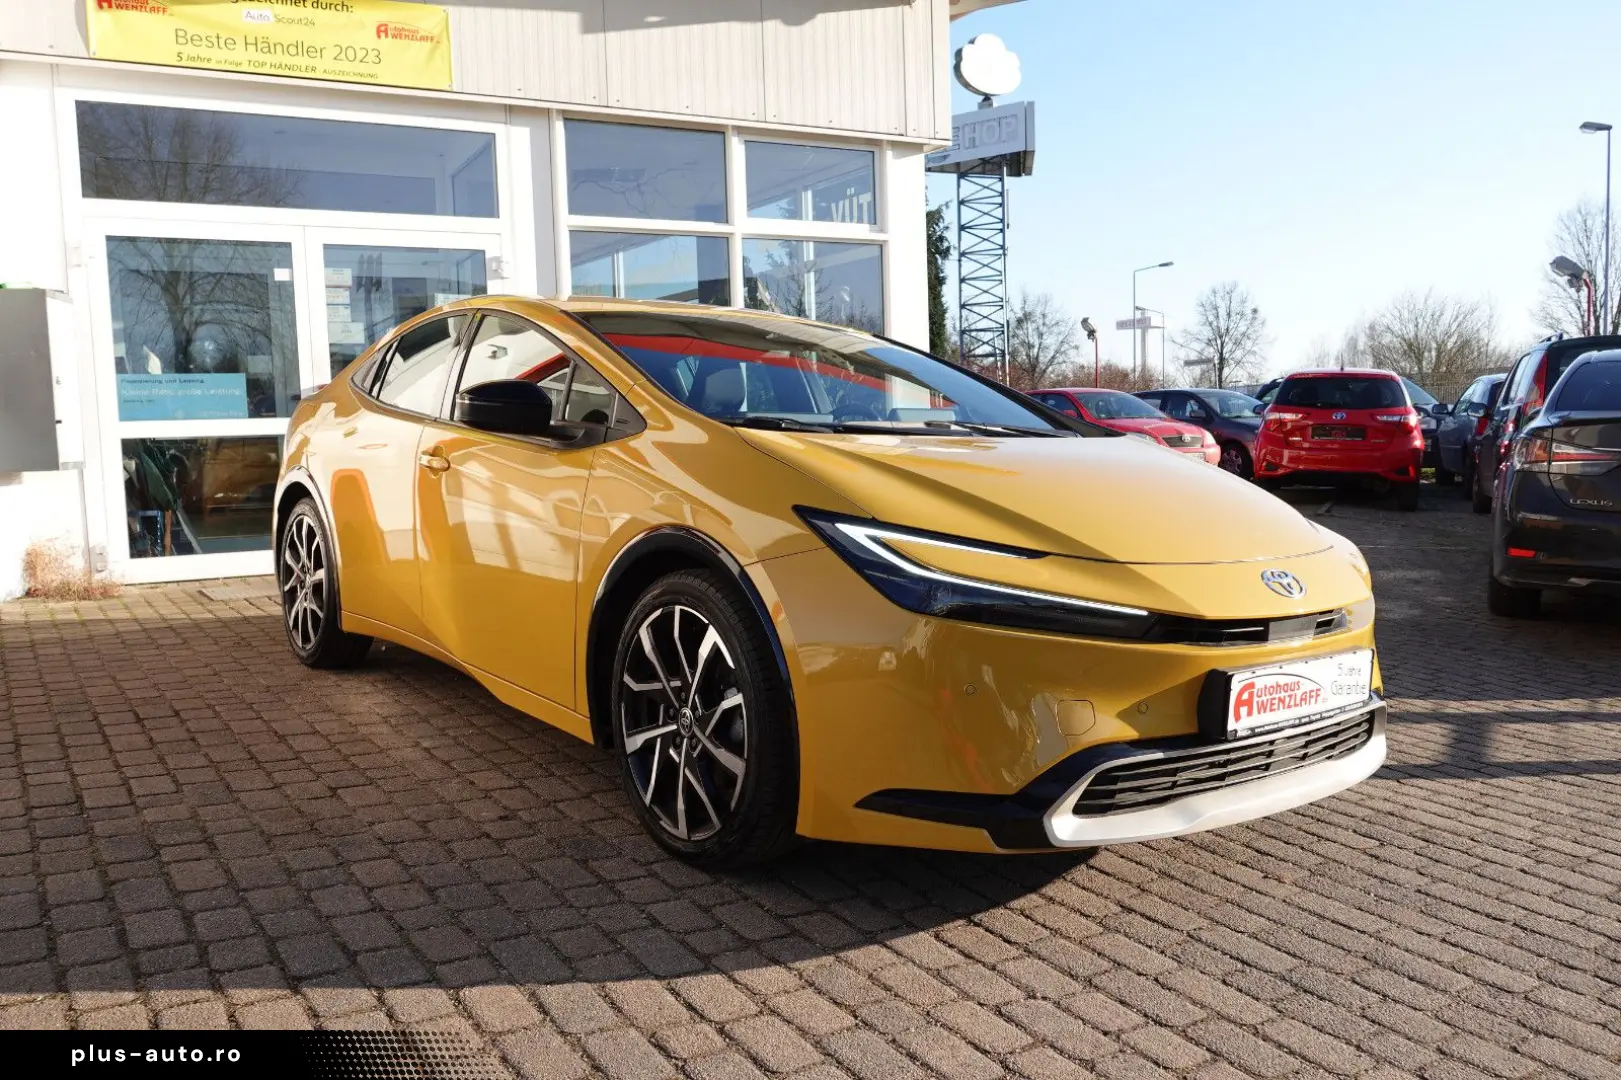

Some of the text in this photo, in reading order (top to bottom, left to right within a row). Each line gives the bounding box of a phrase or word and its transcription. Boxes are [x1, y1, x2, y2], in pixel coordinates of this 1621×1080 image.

[114, 2, 168, 15] WENZLAFF
[311, 0, 353, 13] durch:
[245, 11, 315, 27] Auto Scout24
[175, 28, 382, 65] Beste Händler 2023
[176, 51, 184, 63] 5
[185, 53, 213, 64] Jahre
[247, 59, 267, 69] TOP
[1337, 662, 1343, 677] 5
[1331, 679, 1367, 696] Garantie
[1255, 688, 1322, 715] WENZLAFF
